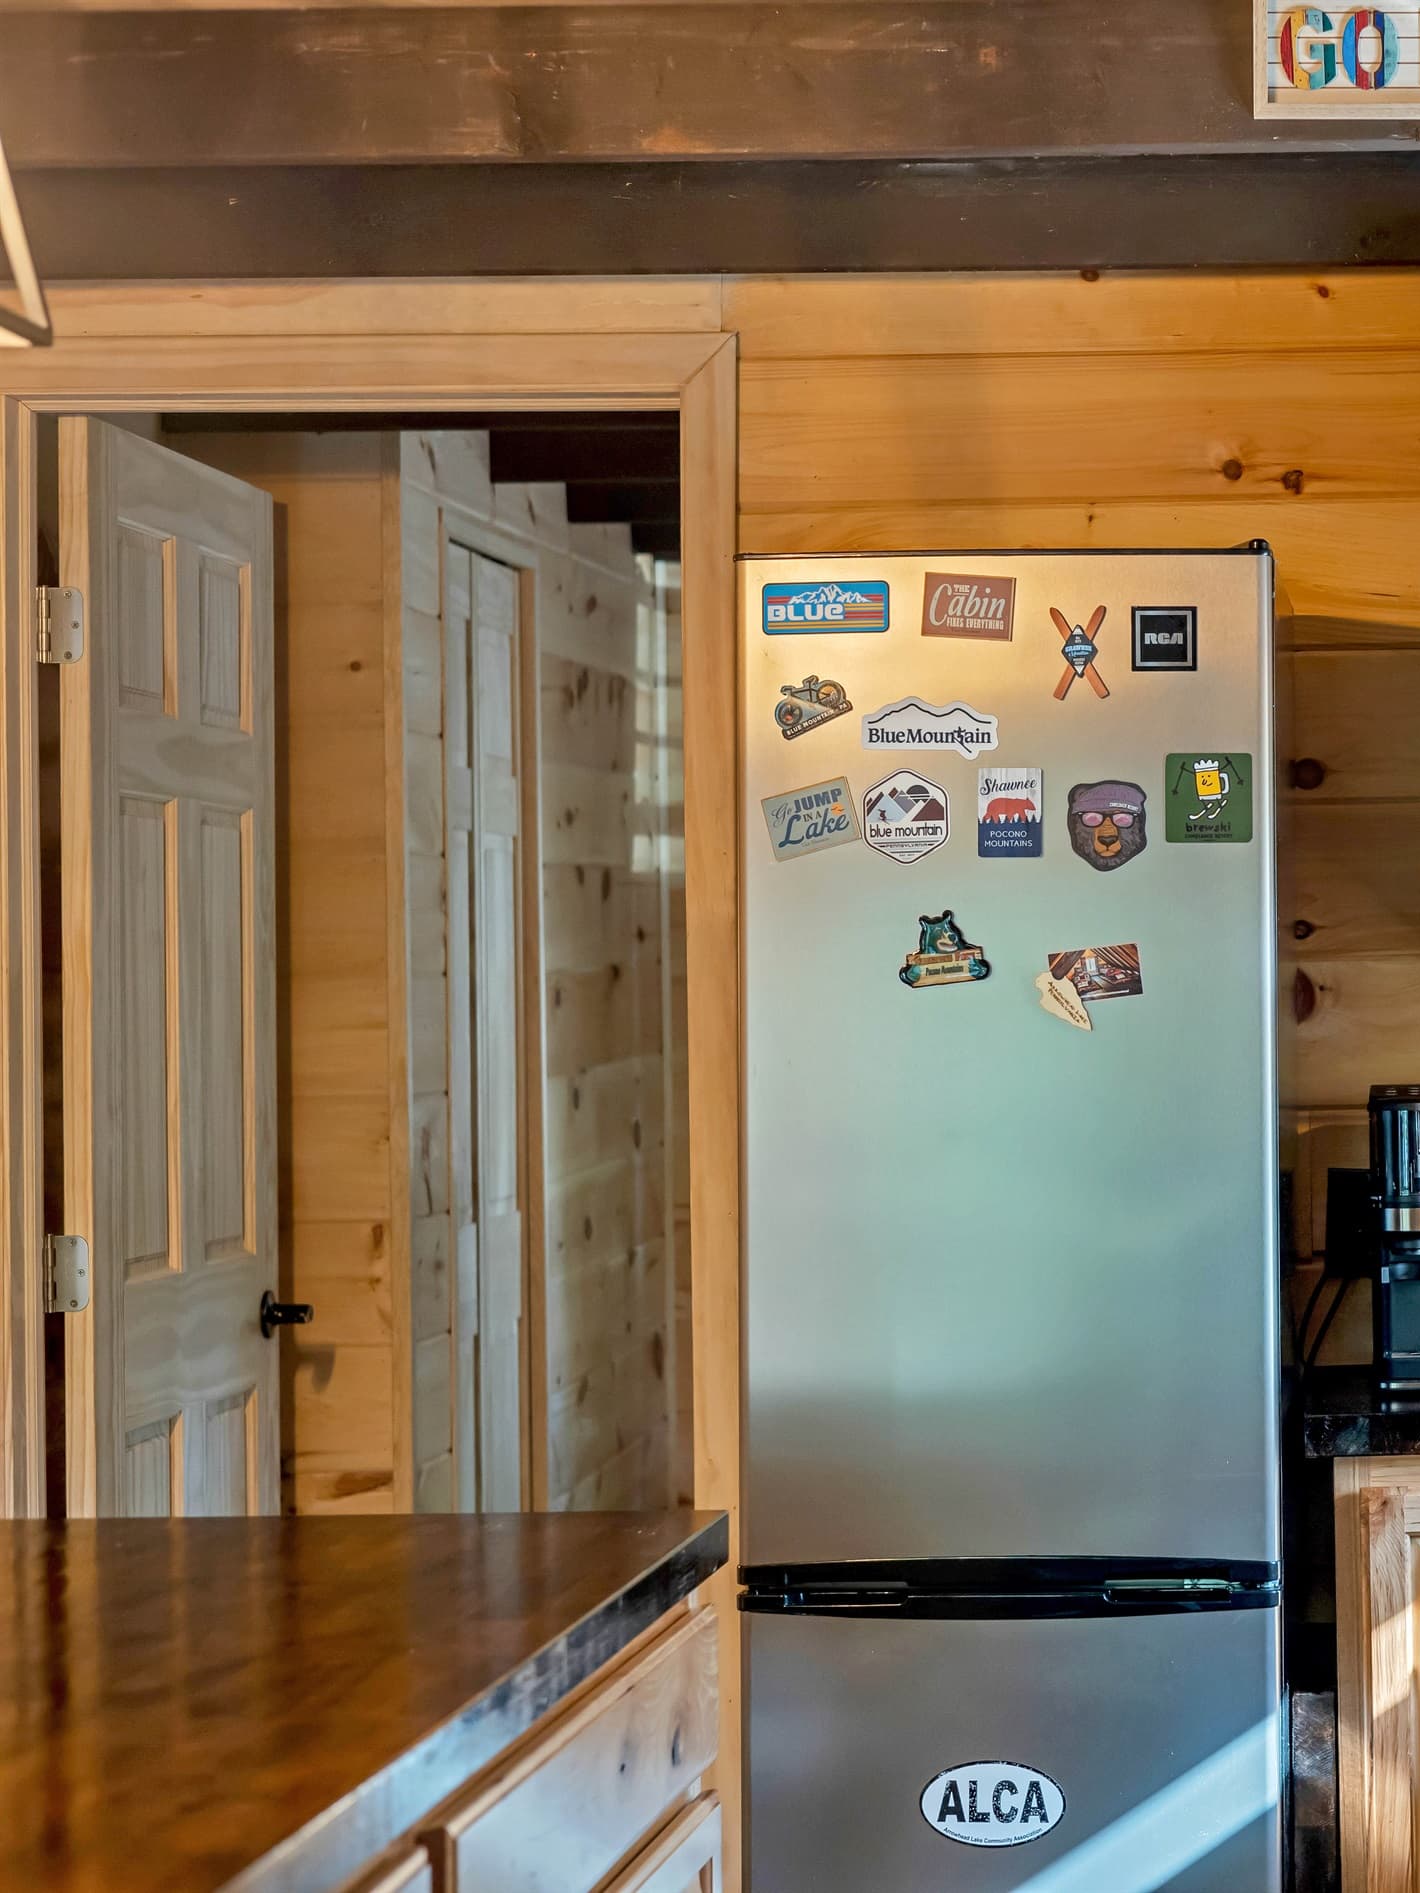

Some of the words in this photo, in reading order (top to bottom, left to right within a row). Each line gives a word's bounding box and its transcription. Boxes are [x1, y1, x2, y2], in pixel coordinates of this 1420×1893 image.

[1279, 8, 1400, 90] GO
[953, 584, 970, 592] THE
[929, 583, 1006, 626] Cabin
[966, 618, 1004, 630] EVERYTHING
[1144, 632, 1184, 645] RCA
[786, 725, 802, 737] BLUE
[803, 709, 835, 728] MOUNTAIN
[979, 777, 1037, 796] Shawnee
[772, 802, 793, 828] Go
[794, 788, 842, 813] JUMP
[803, 811, 814, 822] IN
[814, 810, 823, 820] A
[778, 808, 850, 848] Lake
[869, 824, 892, 838] blue
[895, 822, 943, 837] mountain
[990, 830, 1027, 838] POCONO
[1185, 821, 1231, 832] brewski
[984, 839, 1033, 848] MOUNTAINS
[937, 1780, 1049, 1823] ALCA
[943, 1827, 970, 1841] Arrowhead
[970, 1836, 983, 1844] Lake
[984, 1836, 1013, 1844] Community
[1013, 1827, 1043, 1842] Association
